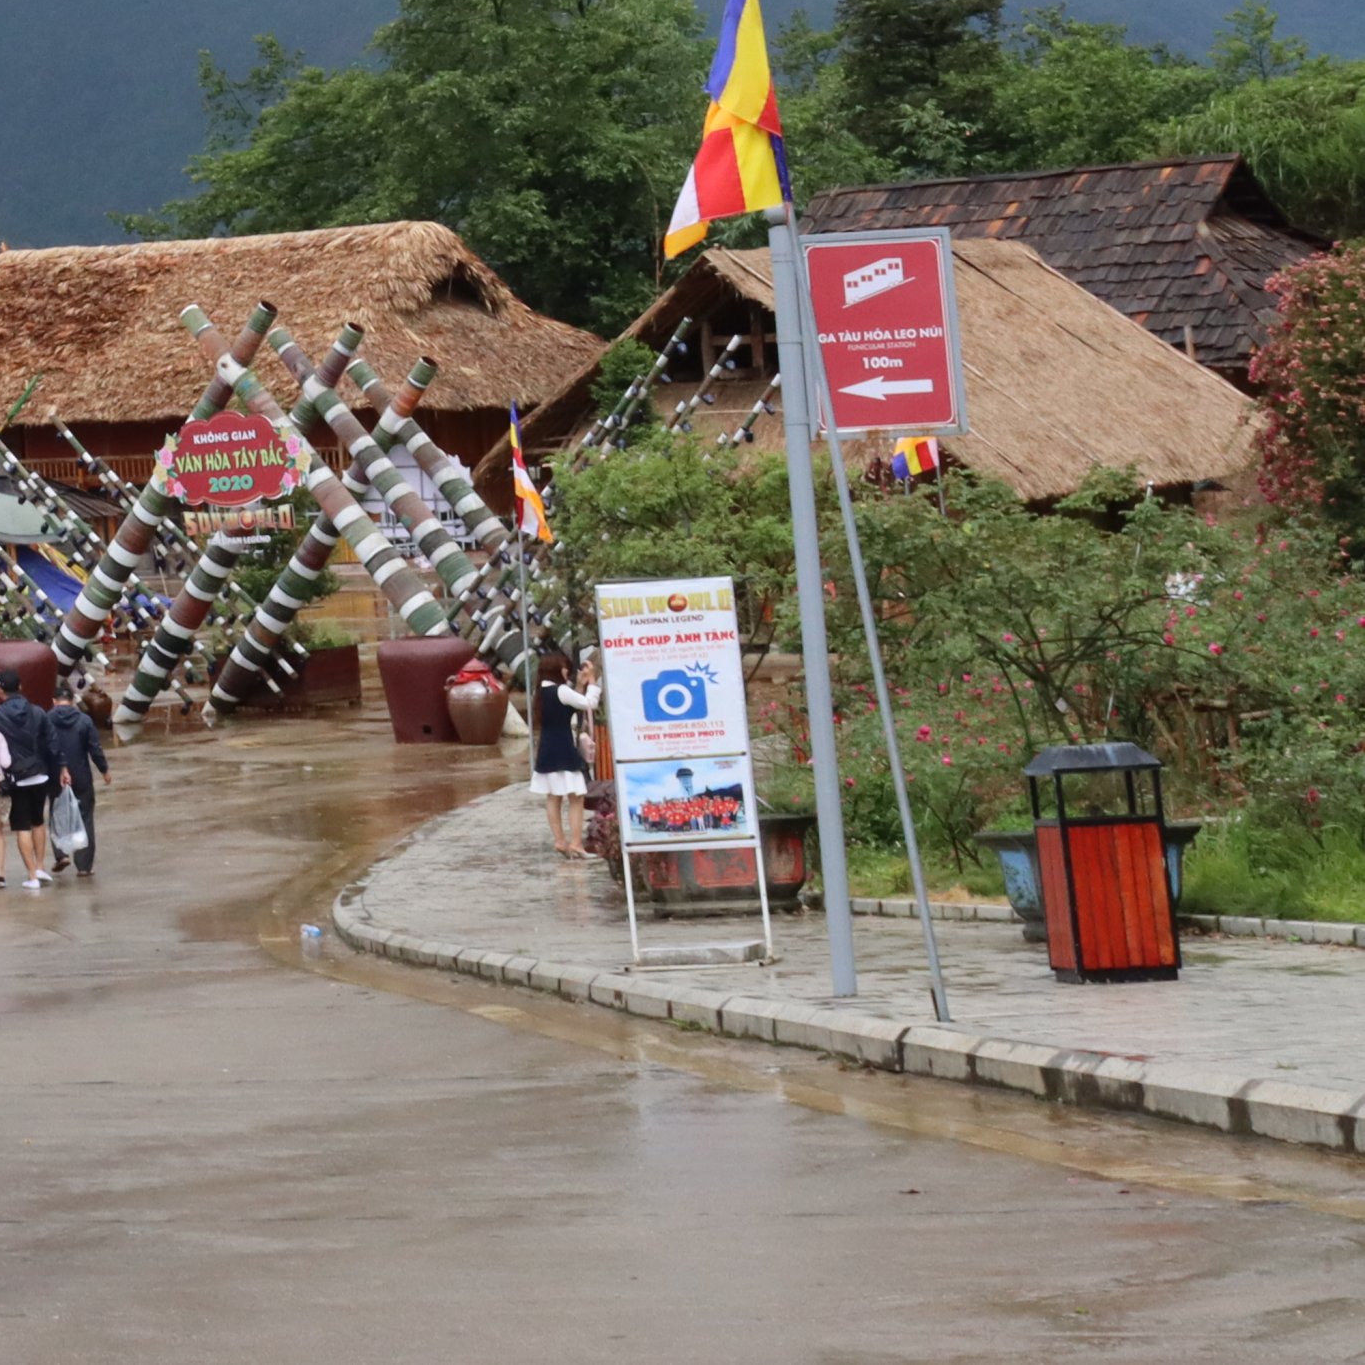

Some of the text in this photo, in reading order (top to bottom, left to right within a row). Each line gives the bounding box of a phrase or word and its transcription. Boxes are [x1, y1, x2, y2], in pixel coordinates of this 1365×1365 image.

[818, 333, 837, 344] GA
[837, 329, 861, 343] TÀU
[894, 327, 917, 340] LEO
[919, 325, 943, 339] NÚI
[887, 341, 916, 349] STATION
[862, 356, 903, 369] 100m
[193, 429, 256, 445] KHÔNG GIAN
[175, 452, 203, 474] VĂN
[232, 446, 258, 469] TÂY
[259, 440, 285, 467] BẮC
[209, 475, 253, 493] 2020
[600, 597, 644, 620] SUN
[630, 614, 704, 626] FANSIPAN LEGEND
